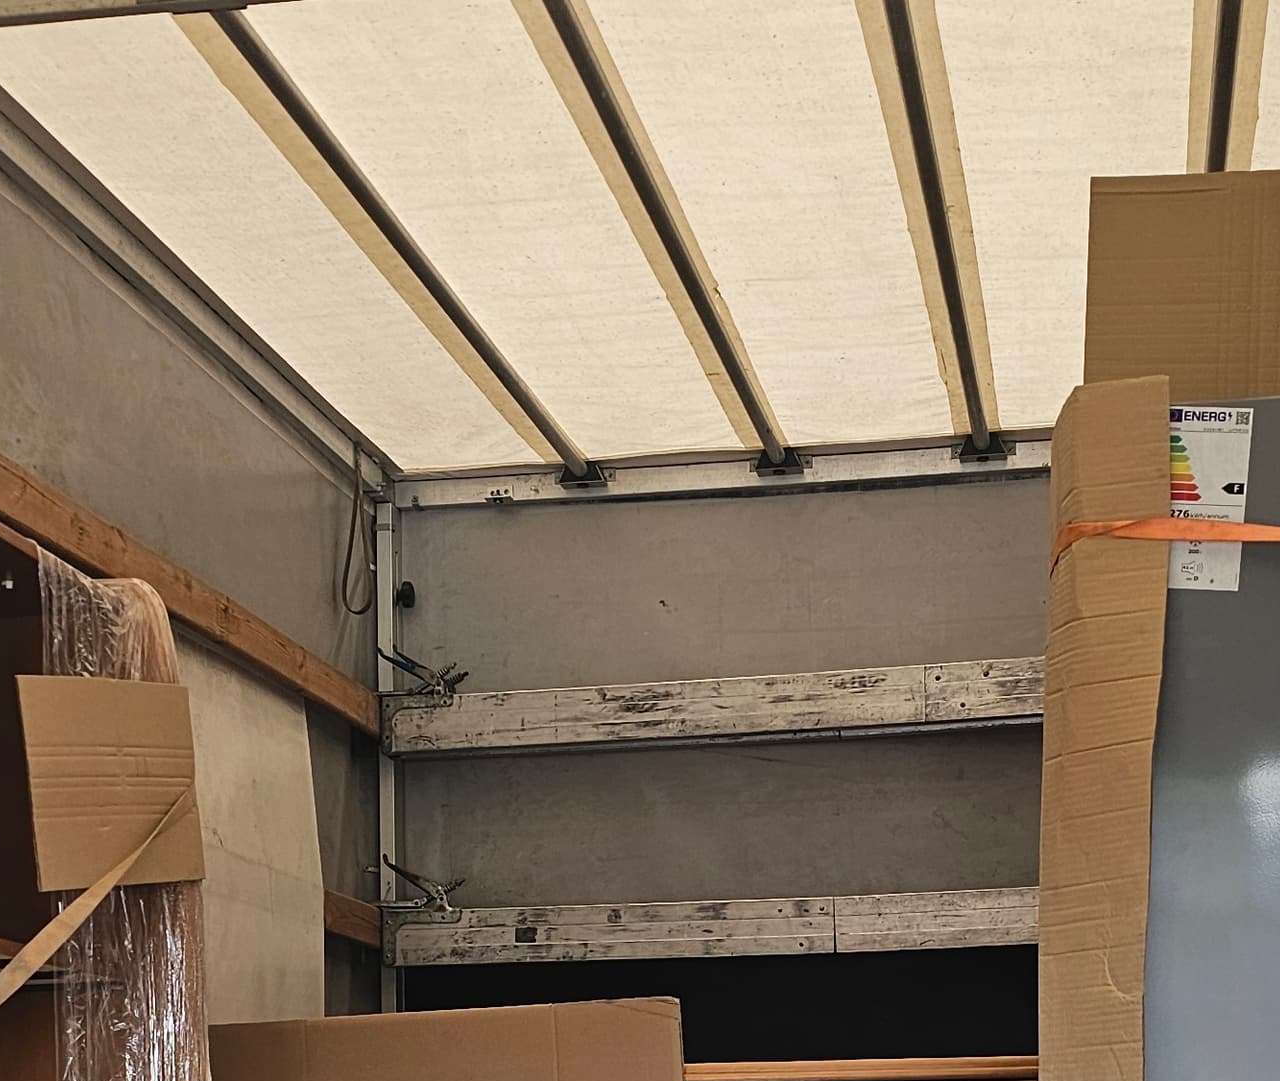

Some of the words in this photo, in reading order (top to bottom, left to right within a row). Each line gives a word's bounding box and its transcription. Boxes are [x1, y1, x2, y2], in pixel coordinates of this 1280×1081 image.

[1184, 410, 1226, 422] ENERG
[1233, 484, 1241, 493] F
[1170, 509, 1190, 518] 276
